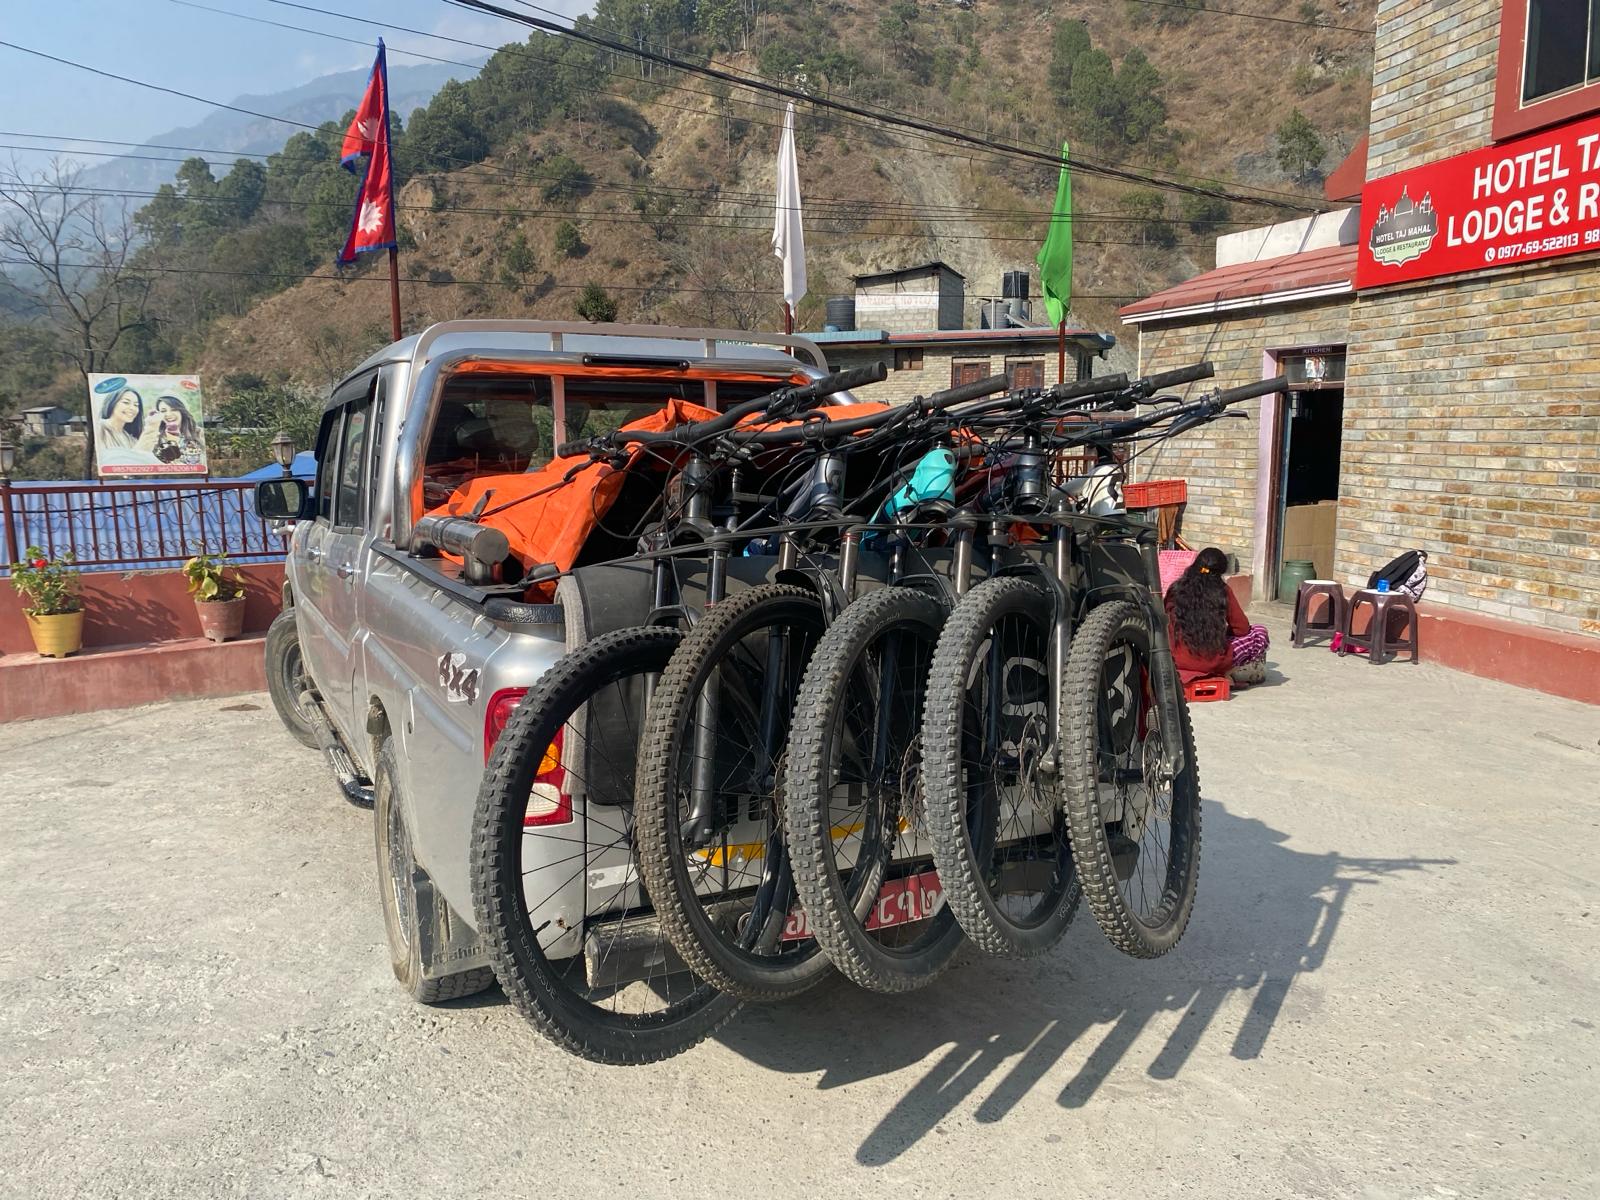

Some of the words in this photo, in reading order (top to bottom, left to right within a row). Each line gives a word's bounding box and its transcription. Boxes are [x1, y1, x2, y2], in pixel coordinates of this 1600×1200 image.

[1472, 145, 1569, 200] HOTEL
[1447, 195, 1544, 247] LODGE
[1549, 188, 1570, 226] &
[1375, 232, 1394, 244] HOTEL
[1395, 229, 1407, 239] TAJ
[1407, 224, 1431, 236] MAHAL
[1397, 239, 1429, 251] RESTAURANT
[1303, 346, 1331, 354] KITCHEN
